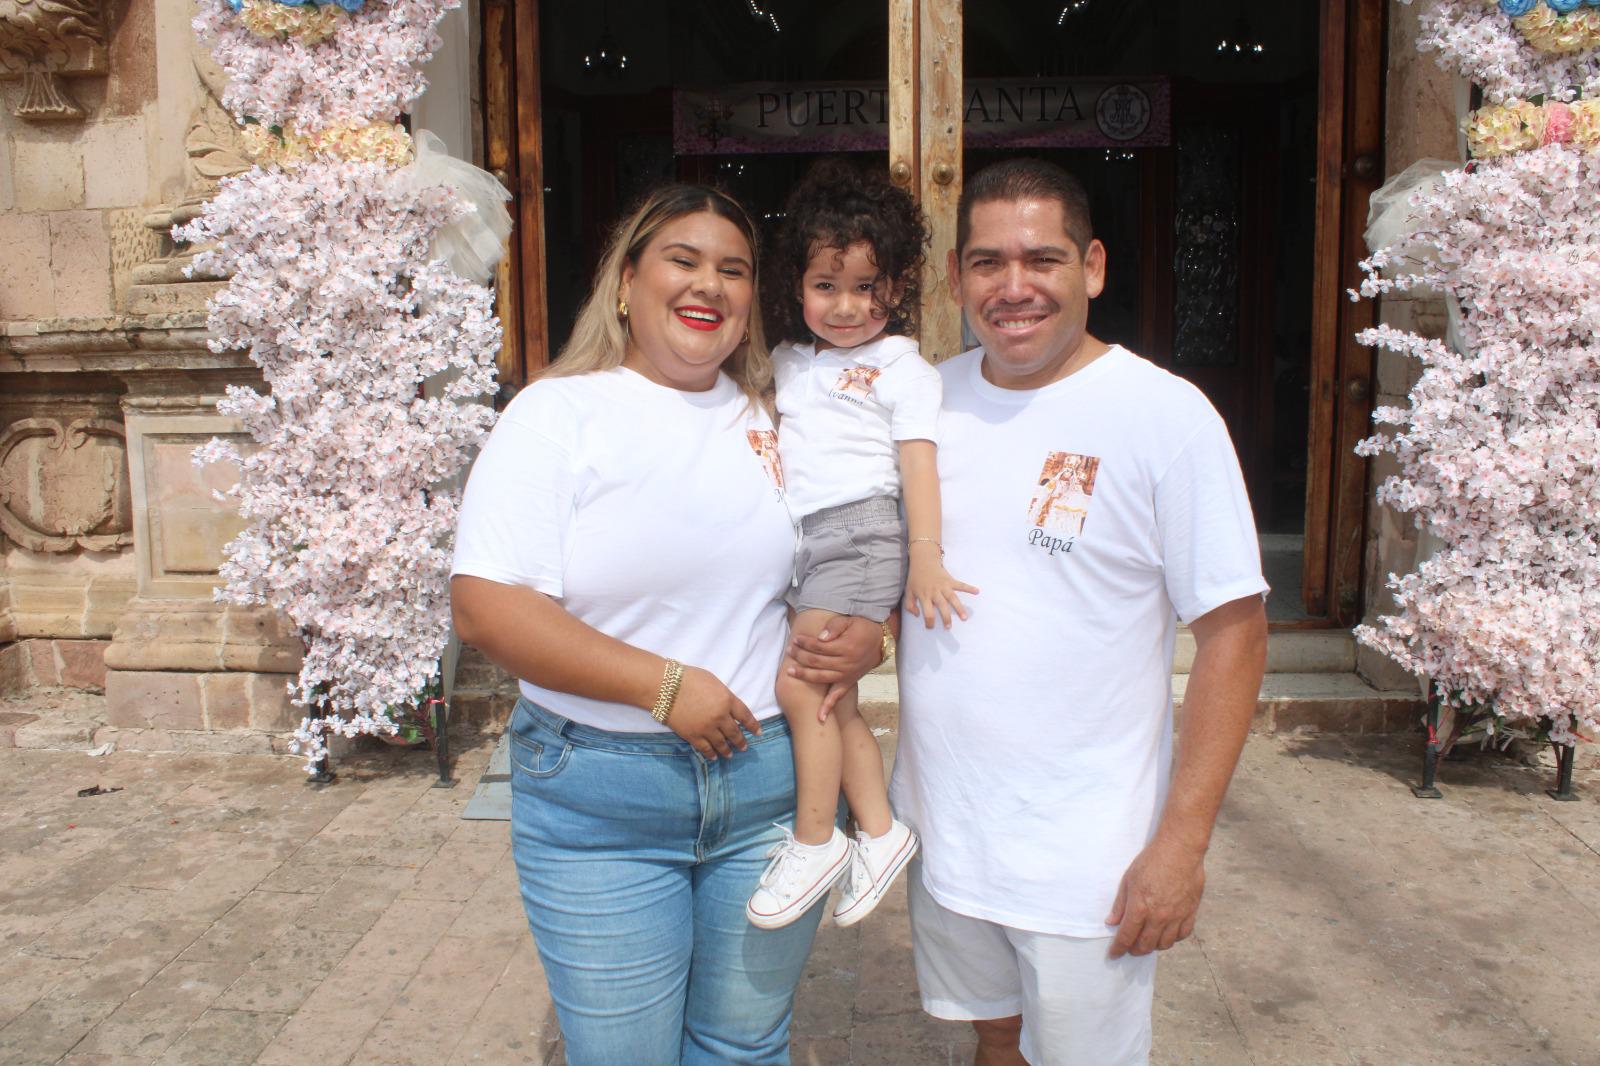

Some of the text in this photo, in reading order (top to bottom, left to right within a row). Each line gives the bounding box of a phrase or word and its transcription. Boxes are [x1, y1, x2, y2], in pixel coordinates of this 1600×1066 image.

[757, 86, 1084, 128] PUERT ANTA
[1028, 528, 1074, 556] Papá
